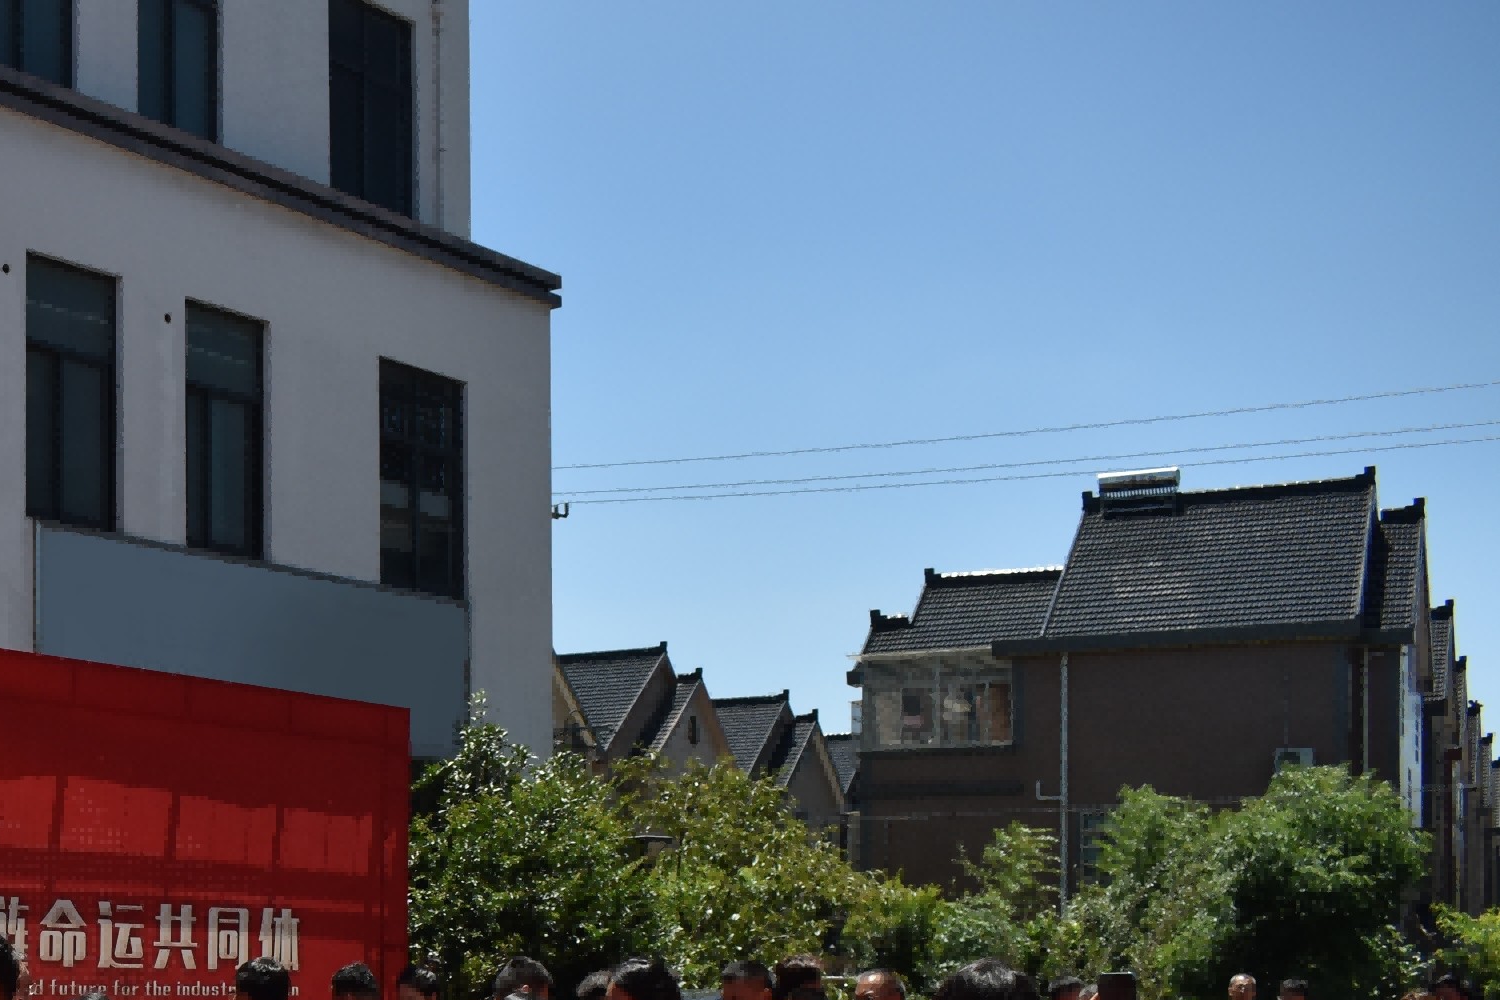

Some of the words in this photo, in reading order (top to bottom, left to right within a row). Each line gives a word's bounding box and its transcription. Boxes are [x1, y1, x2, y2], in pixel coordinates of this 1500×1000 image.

[49, 979, 108, 996] future
[112, 979, 139, 996] for
[144, 980, 171, 996] the
